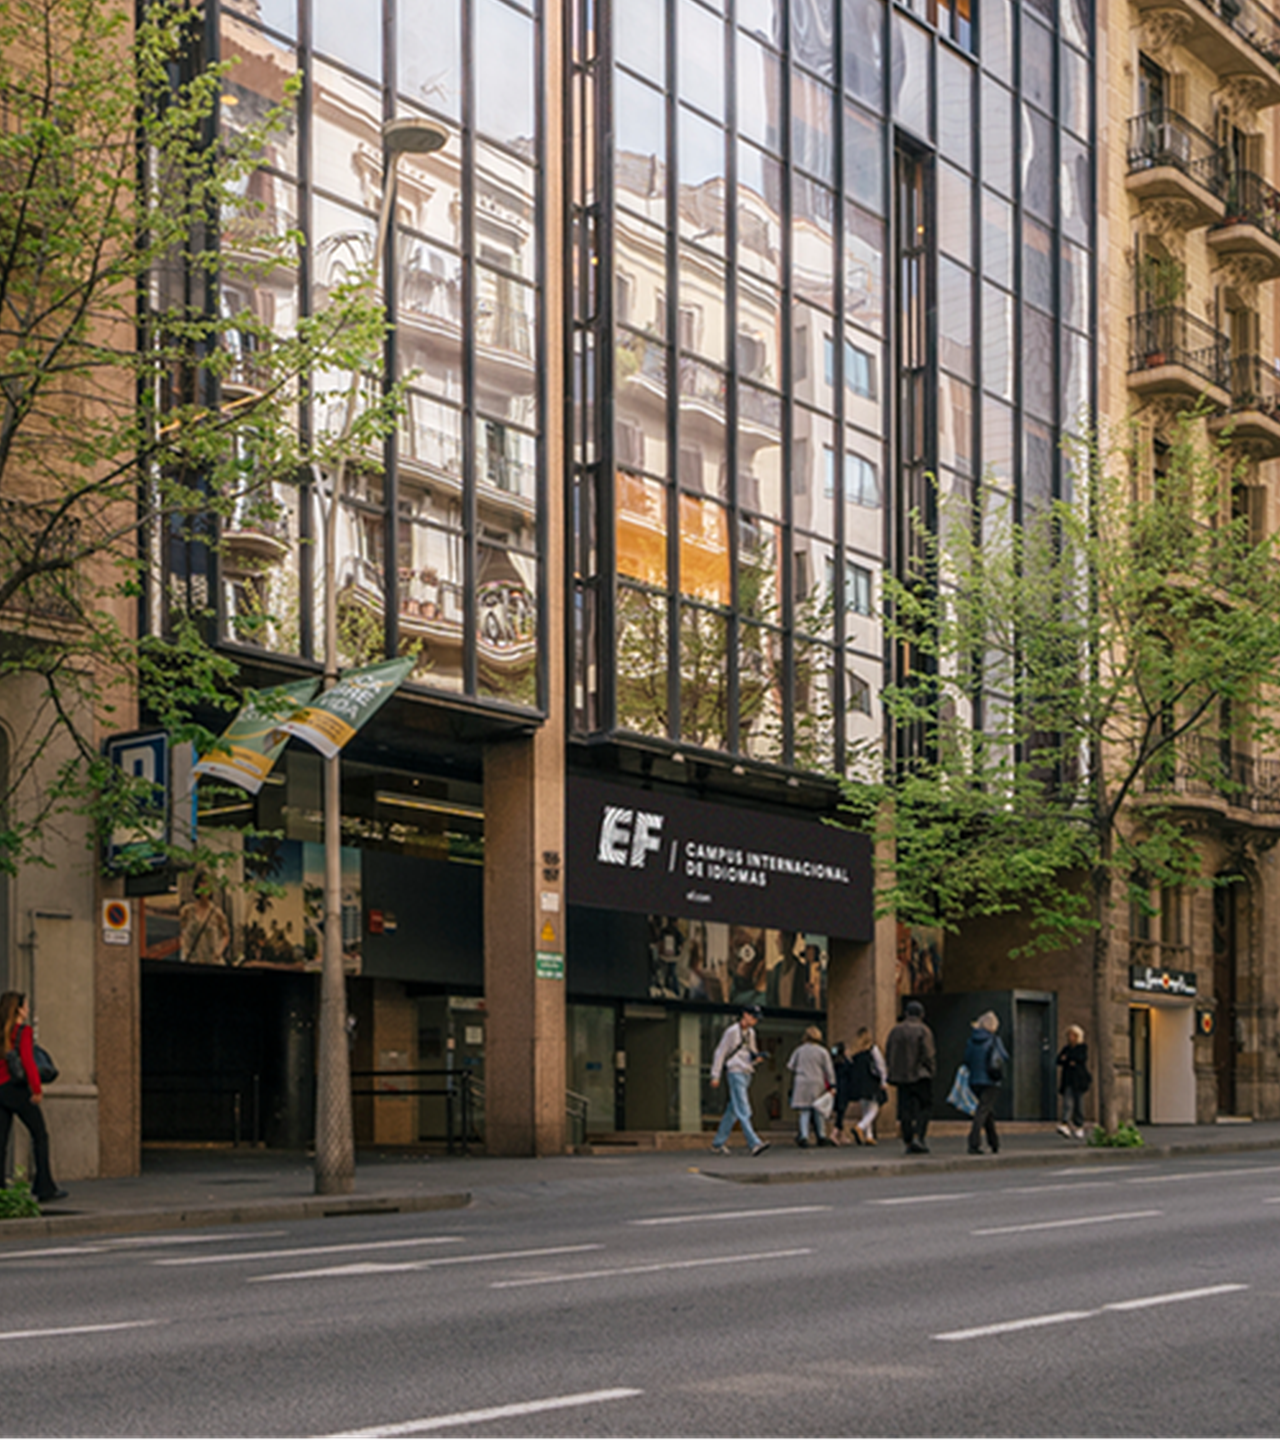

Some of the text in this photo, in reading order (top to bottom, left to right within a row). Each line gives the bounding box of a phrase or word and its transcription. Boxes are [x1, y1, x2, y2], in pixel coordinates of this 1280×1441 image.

[597, 806, 664, 868] EF
[685, 842, 850, 883] CAMPUS INTERNACIONAL
[686, 861, 767, 886] DE IDIOMAS
